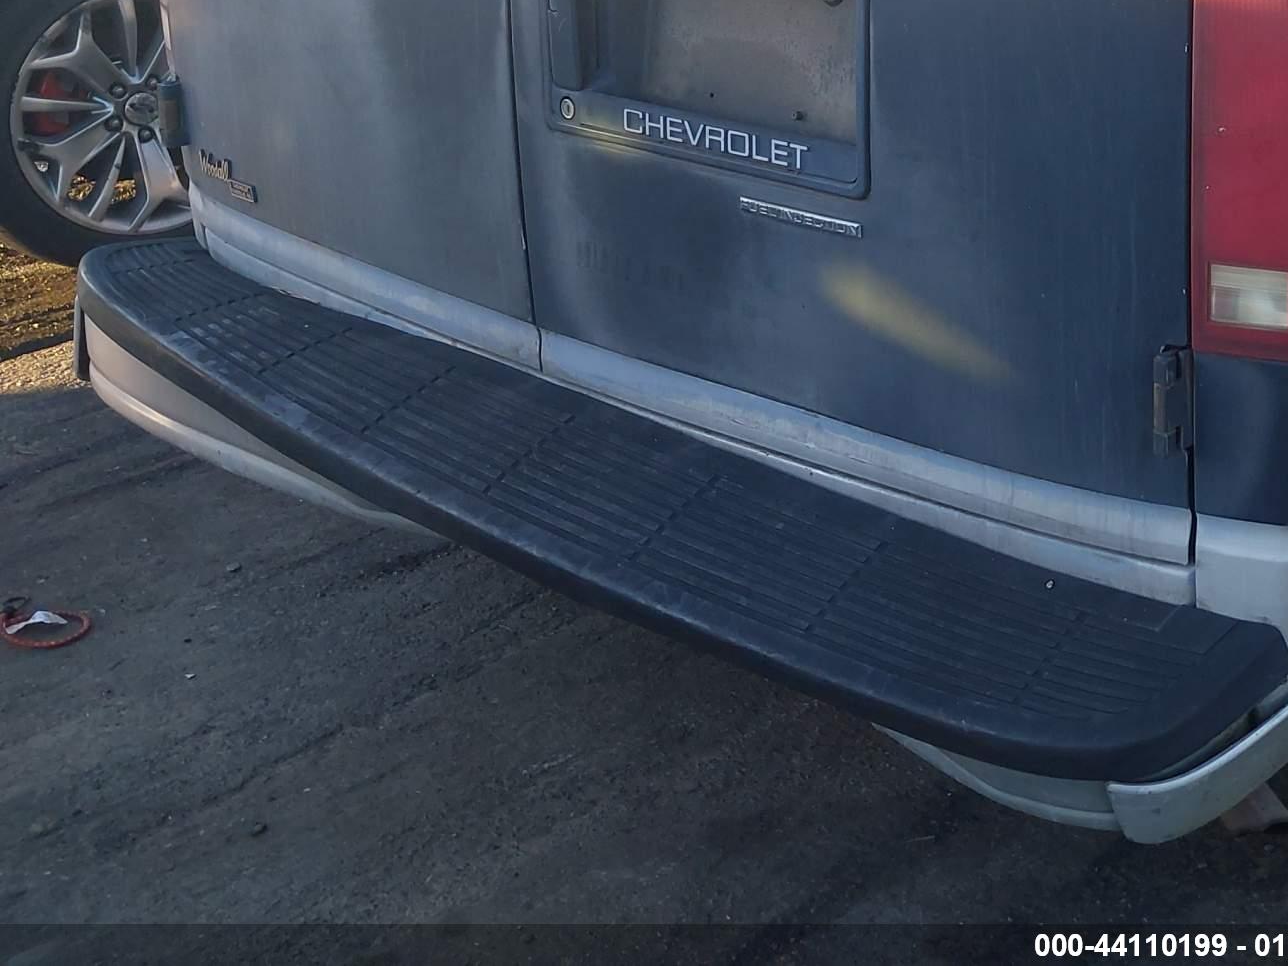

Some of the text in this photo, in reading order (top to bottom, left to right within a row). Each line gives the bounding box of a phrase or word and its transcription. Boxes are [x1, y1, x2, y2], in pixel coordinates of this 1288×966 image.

[623, 108, 808, 169] CHEVROLET
[739, 198, 863, 238] FUEL INJECTION
